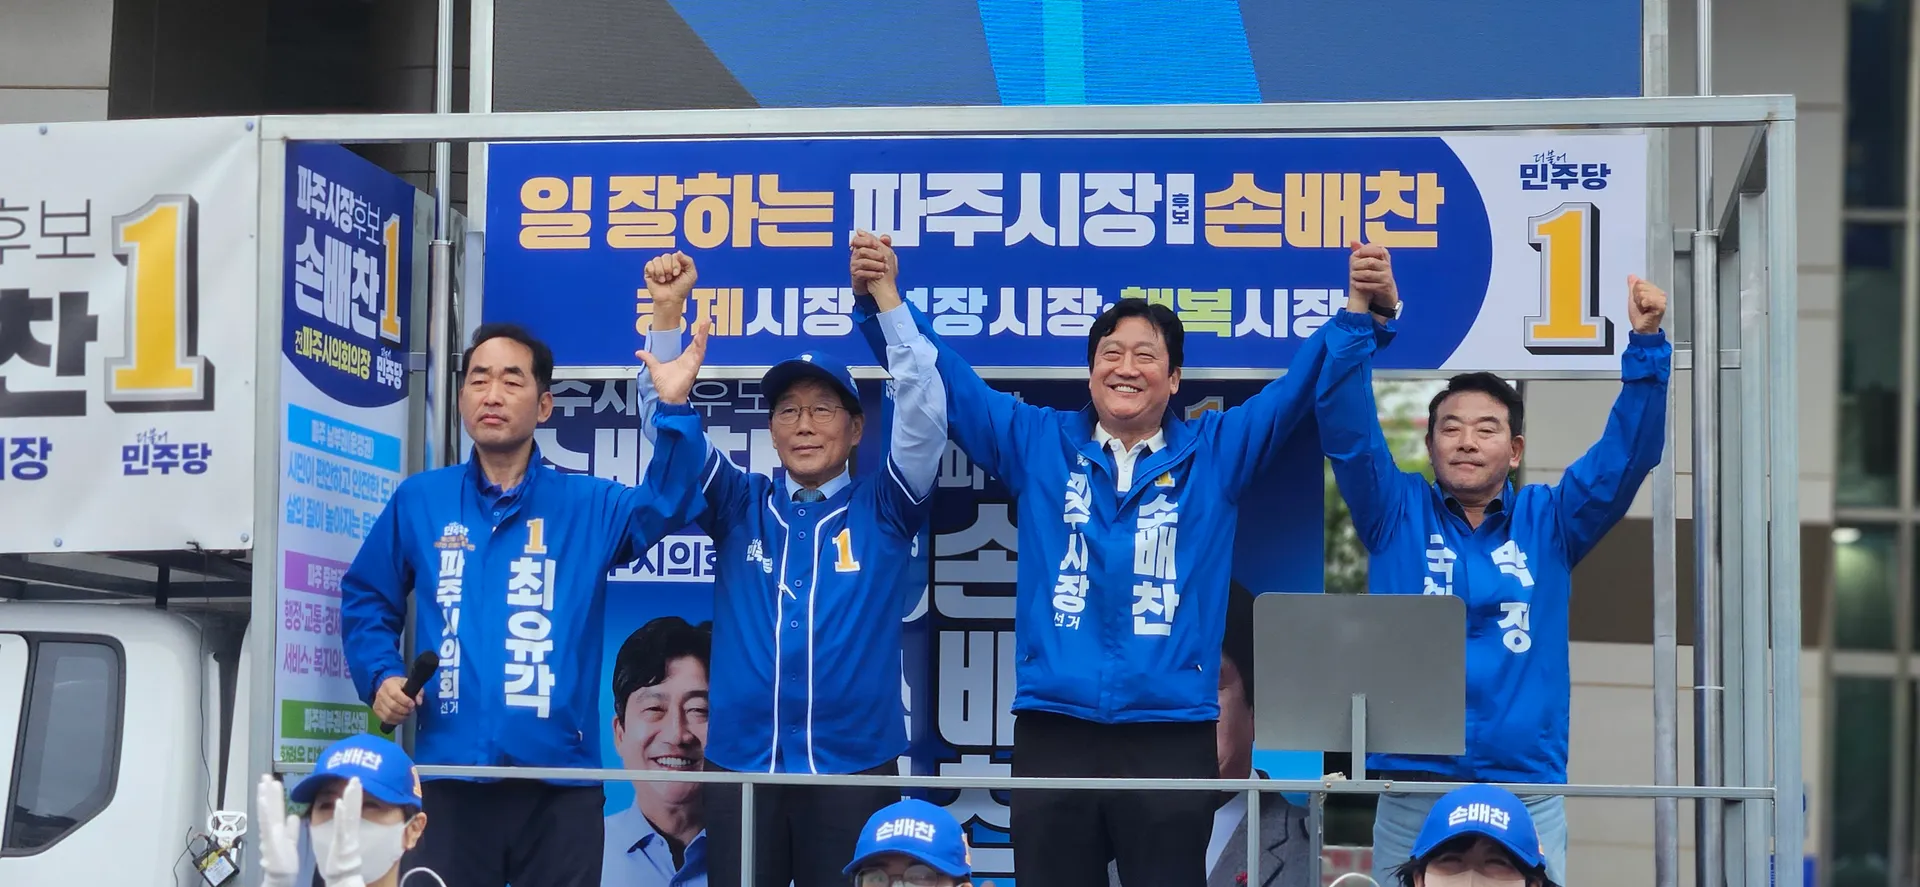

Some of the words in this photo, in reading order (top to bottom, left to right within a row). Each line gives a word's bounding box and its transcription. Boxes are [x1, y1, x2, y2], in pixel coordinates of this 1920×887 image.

[1533, 150, 1567, 165] 더불어
[1519, 163, 1612, 190] 민주당
[519, 175, 593, 250] 일
[606, 172, 834, 249] 잘하는
[849, 172, 1162, 247] 파주시장
[1172, 191, 1190, 226] 후보
[1205, 171, 1445, 248] 손배찬
[295, 225, 380, 340] 손배찬
[380, 213, 401, 345] 1
[1524, 202, 1614, 355] 1
[104, 194, 215, 414] 1
[376, 355, 403, 390] 민주당
[0, 437, 53, 481] 장
[121, 443, 212, 476] 민주당
[524, 517, 547, 554] 1
[831, 527, 861, 572] 1
[1132, 493, 1180, 637] 손배찬
[504, 556, 556, 719] 최유각
[1053, 612, 1081, 630] 선거
[440, 701, 459, 715] 선거
[326, 748, 382, 771] 손배찬
[875, 818, 936, 842] 손배찬
[1448, 803, 1510, 830] 손배찬
